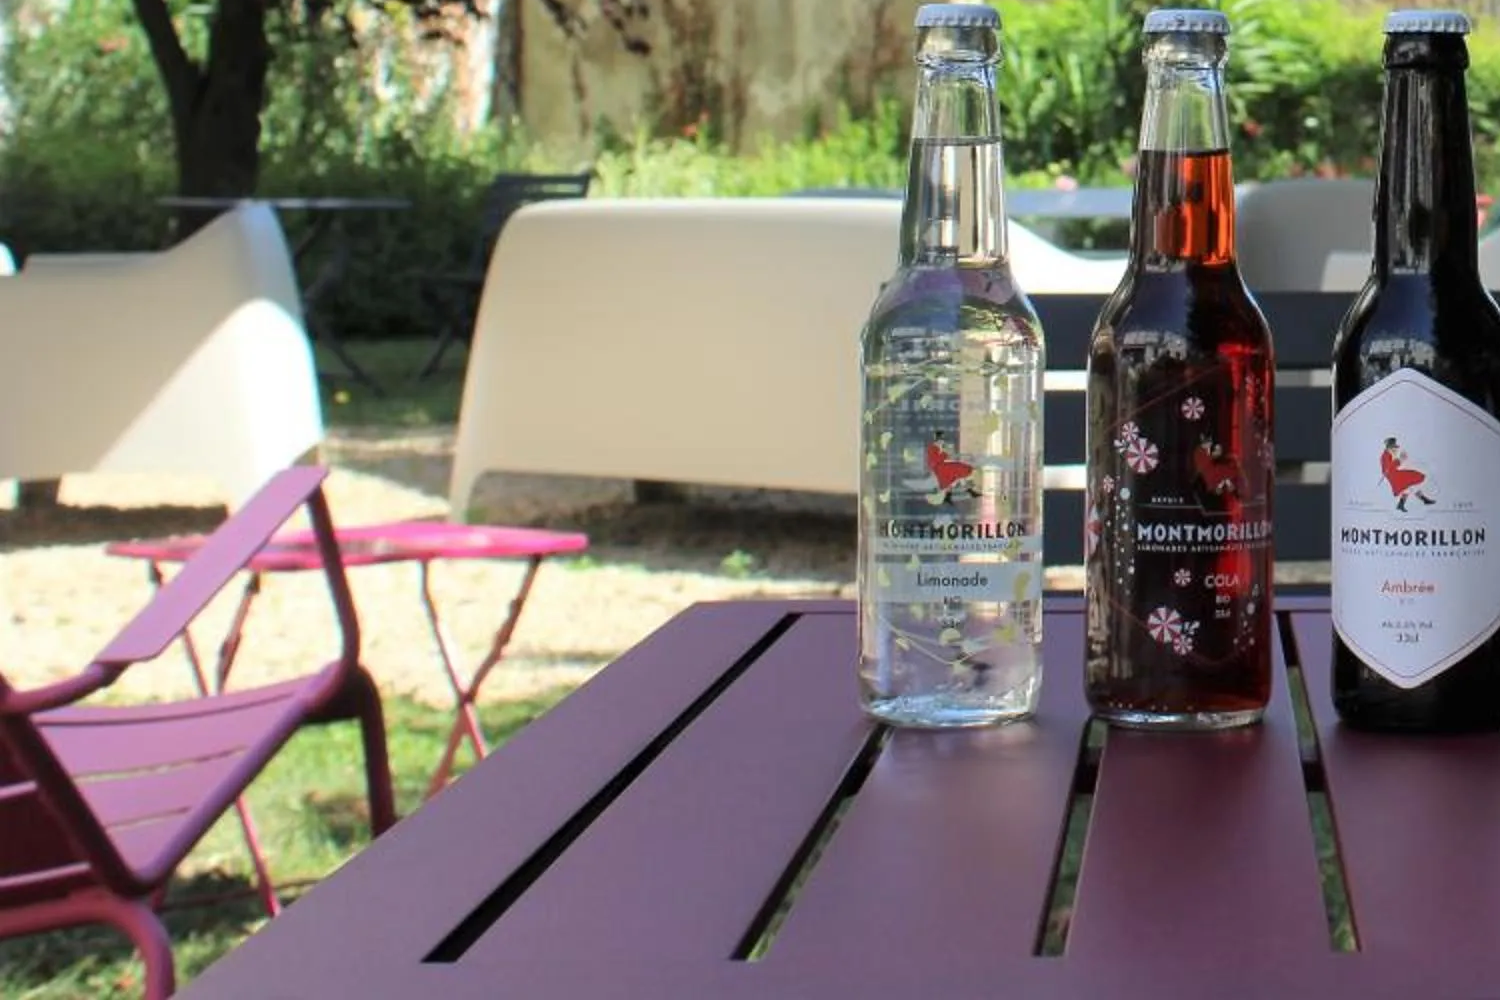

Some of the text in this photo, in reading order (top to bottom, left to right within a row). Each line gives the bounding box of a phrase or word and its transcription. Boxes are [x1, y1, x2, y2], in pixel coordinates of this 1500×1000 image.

[1341, 527, 1485, 547] MONTMORILLON
[917, 571, 989, 588] Limonade
[1204, 574, 1240, 588] COLA
[1381, 579, 1435, 594] Ambrée
